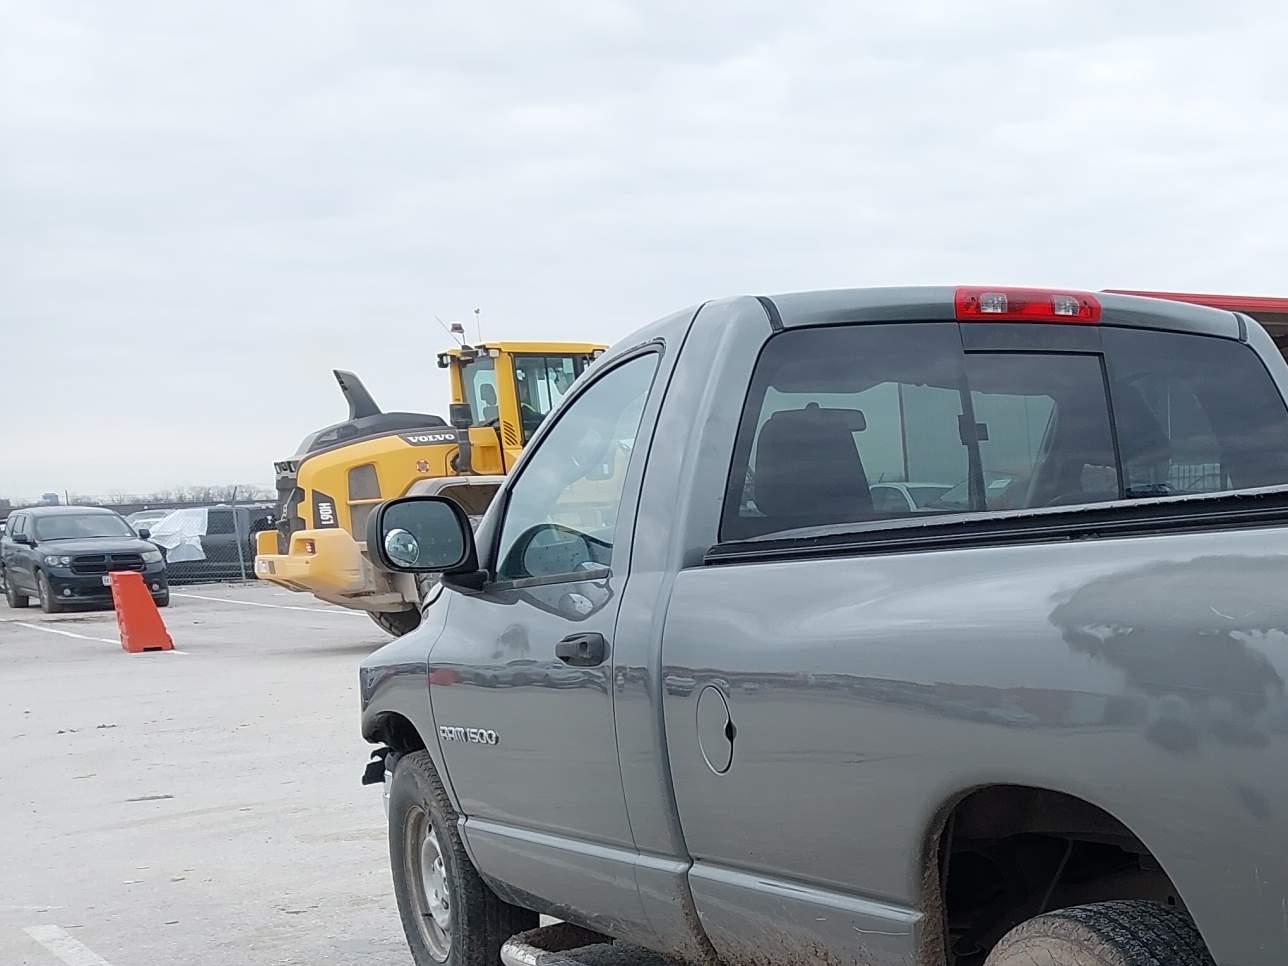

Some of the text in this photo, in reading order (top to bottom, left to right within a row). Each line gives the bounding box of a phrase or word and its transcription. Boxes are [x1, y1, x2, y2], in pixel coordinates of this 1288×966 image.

[407, 433, 455, 442] VOLVO
[318, 502, 334, 524] L90H
[466, 727, 497, 745] 1500
